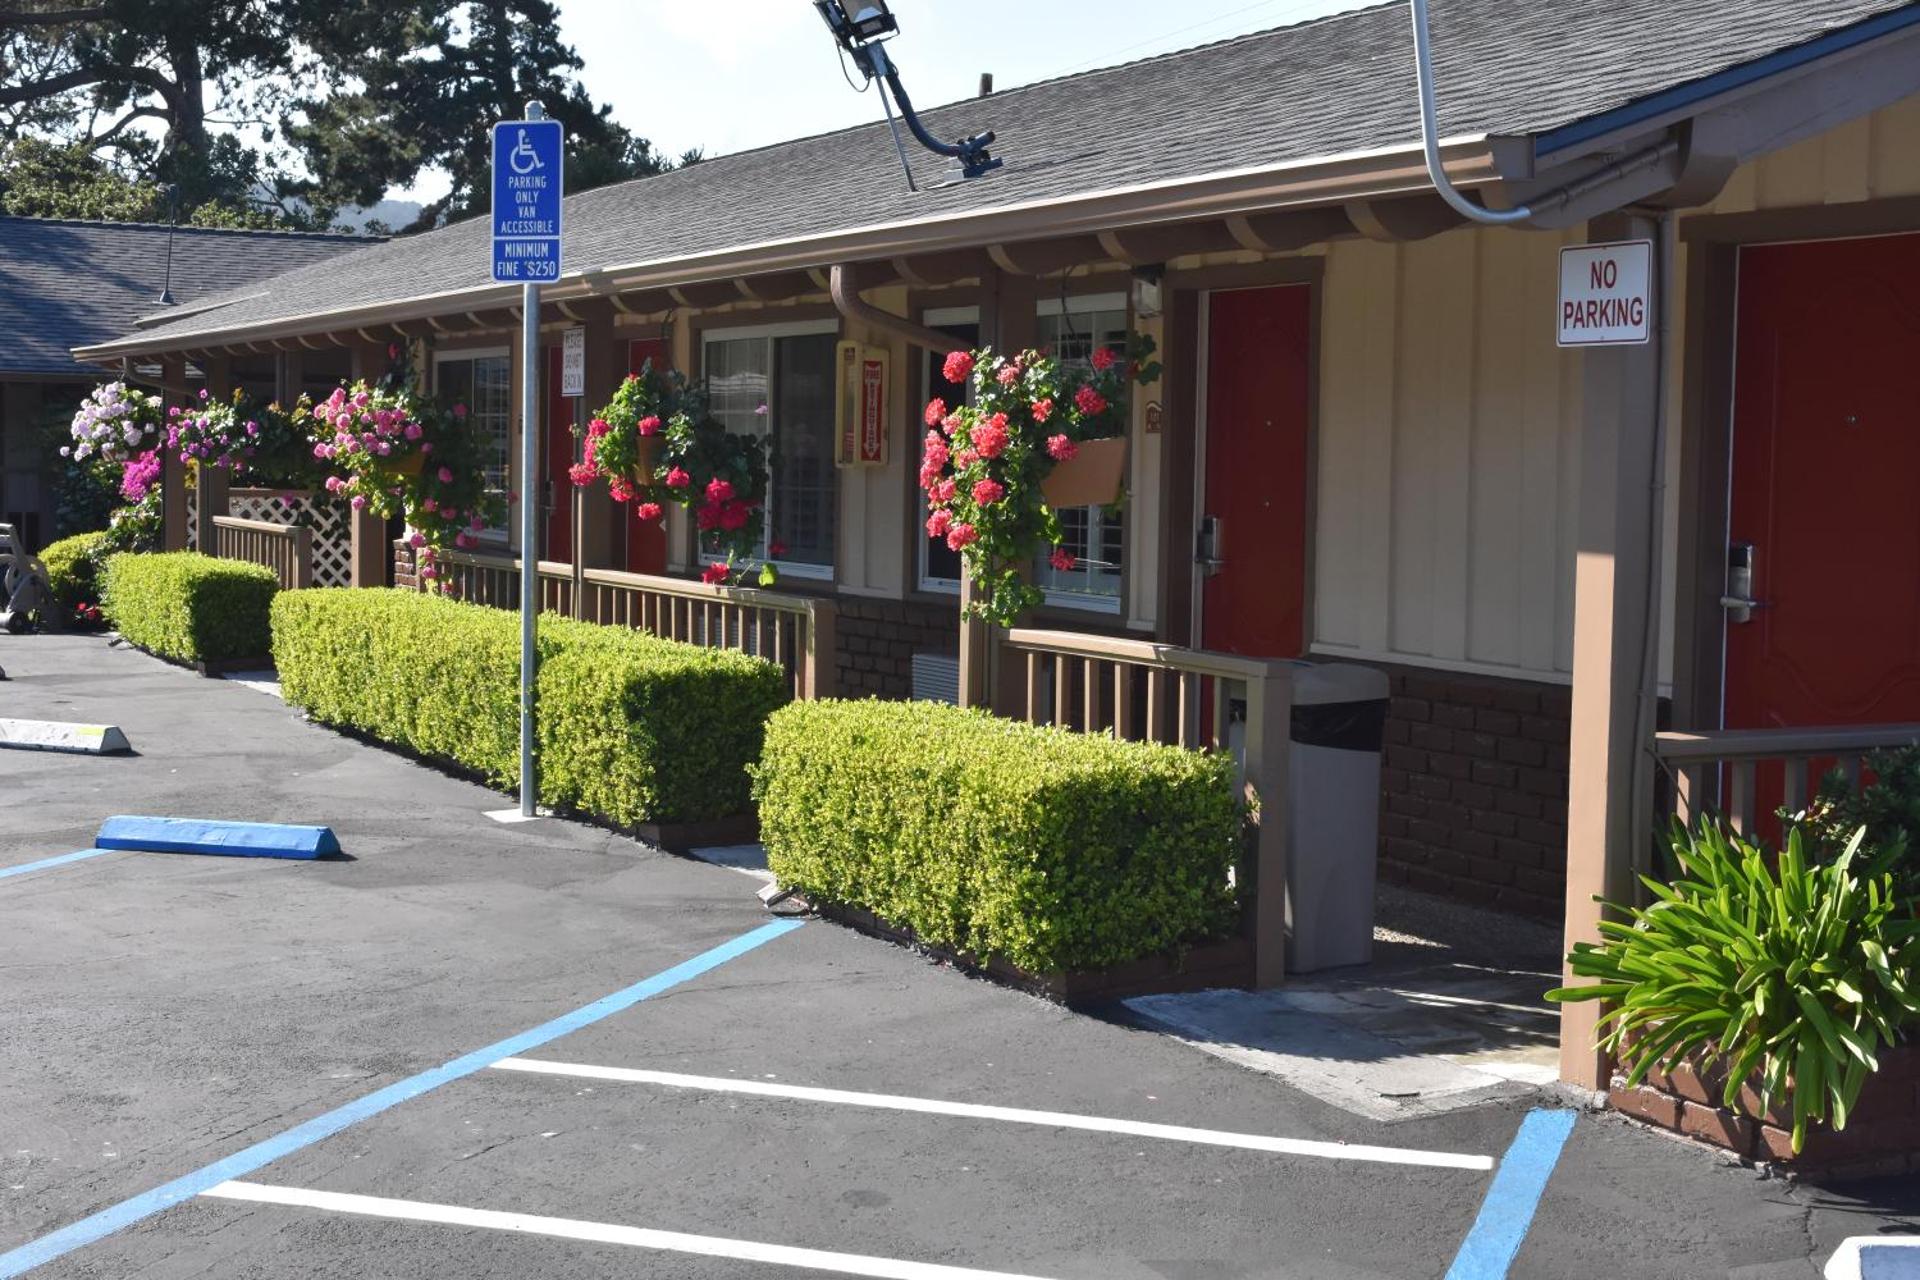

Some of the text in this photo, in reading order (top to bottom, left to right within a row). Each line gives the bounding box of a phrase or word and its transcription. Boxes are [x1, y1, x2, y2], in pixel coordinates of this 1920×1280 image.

[508, 175, 547, 189] PARKING
[515, 190, 539, 204] ONLY
[518, 205, 536, 218] VAN
[501, 220, 554, 234] ACCESSIBLE
[505, 242, 549, 257] MINIMUM
[497, 261, 520, 276] FINE
[1591, 259, 1617, 289] NO
[1563, 297, 1644, 330] PARKING
